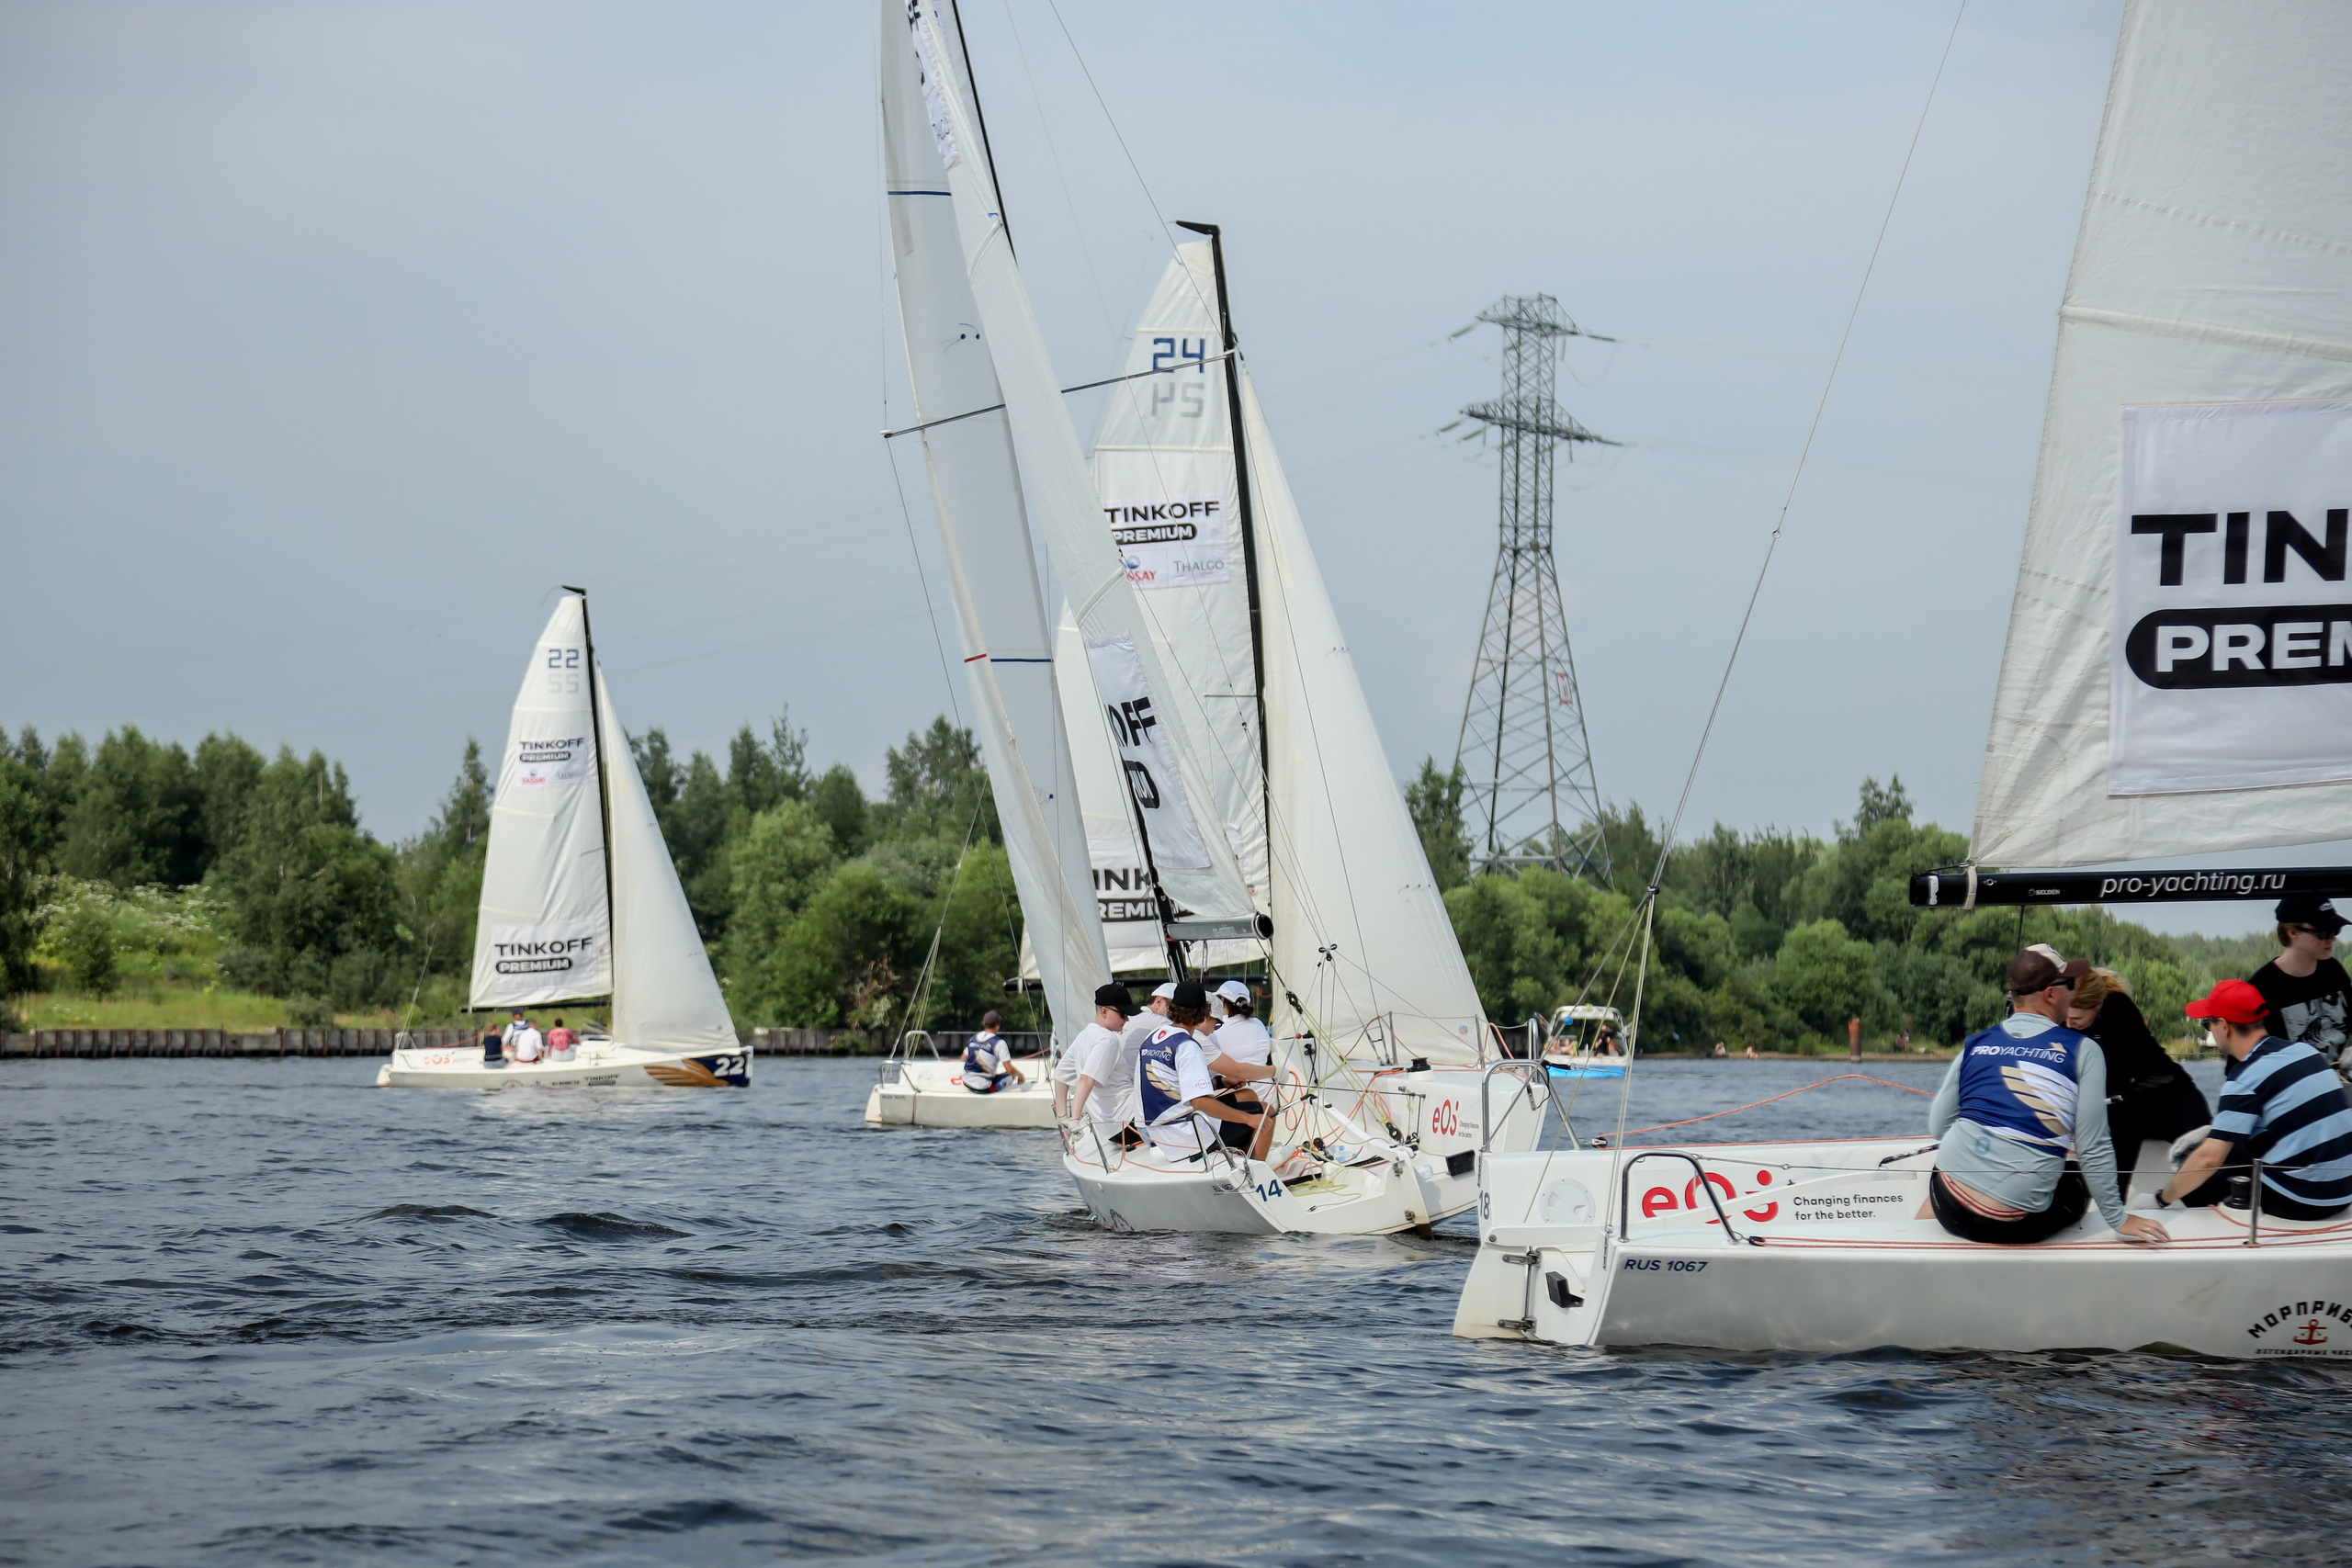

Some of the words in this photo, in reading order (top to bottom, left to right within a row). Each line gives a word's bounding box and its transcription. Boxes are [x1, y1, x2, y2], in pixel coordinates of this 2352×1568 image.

[1153, 337, 1204, 373] 24
[1104, 501, 1220, 523] TINKOFF
[1114, 525, 1193, 542] PREMIUM
[548, 649, 579, 669] 22
[520, 738, 583, 750] TINKOFF
[522, 752, 570, 761] PREMIUM
[2098, 872, 2286, 897] pro-yachting.ru
[495, 937, 593, 955] TINKOFF
[500, 958, 569, 972] PREMIUM
[1971, 1045, 2066, 1064] PROYACHTING
[714, 1057, 745, 1077] 22
[1256, 1179, 1283, 1201] 14
[1478, 1190, 1490, 1220] 18
[1793, 1195, 1850, 1207] Changing
[1853, 1194, 1903, 1203] finances
[1795, 1211, 1812, 1221] for
[1815, 1211, 1834, 1220] the
[1838, 1210, 1876, 1219] better.
[1624, 1259, 1661, 1270] RUS
[1667, 1261, 1708, 1272] 1067
[2247, 1301, 2352, 1338] МОРПРИБ
